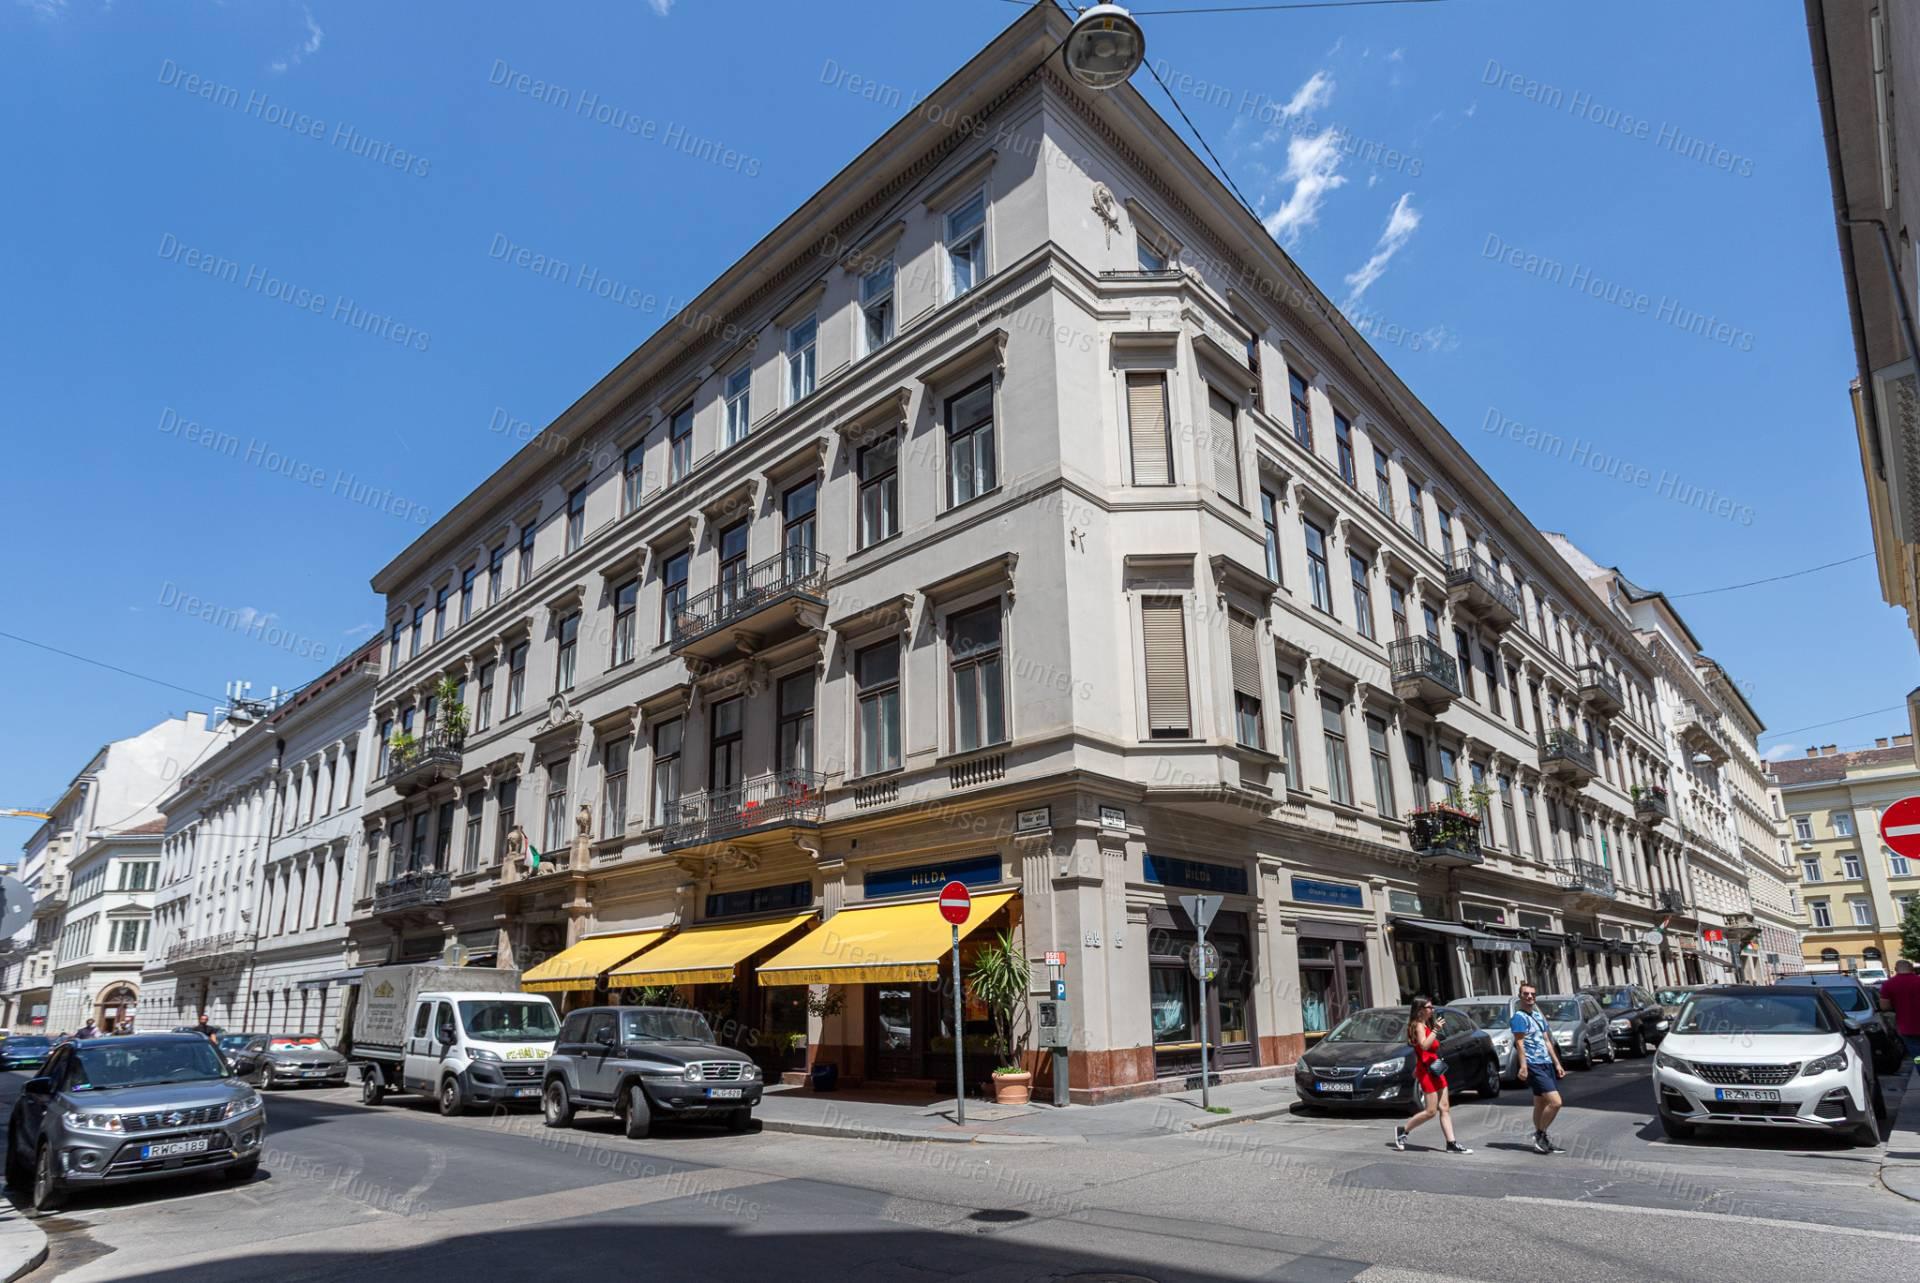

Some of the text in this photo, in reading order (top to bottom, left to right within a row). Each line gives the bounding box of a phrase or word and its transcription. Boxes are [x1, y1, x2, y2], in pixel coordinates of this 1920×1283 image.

[911, 871, 946, 886] HILDA
[1185, 868, 1210, 882] HILDA
[1057, 984, 1065, 996] P
[1725, 1090, 1776, 1100] RZM-610
[152, 1141, 205, 1156] RWC-189
